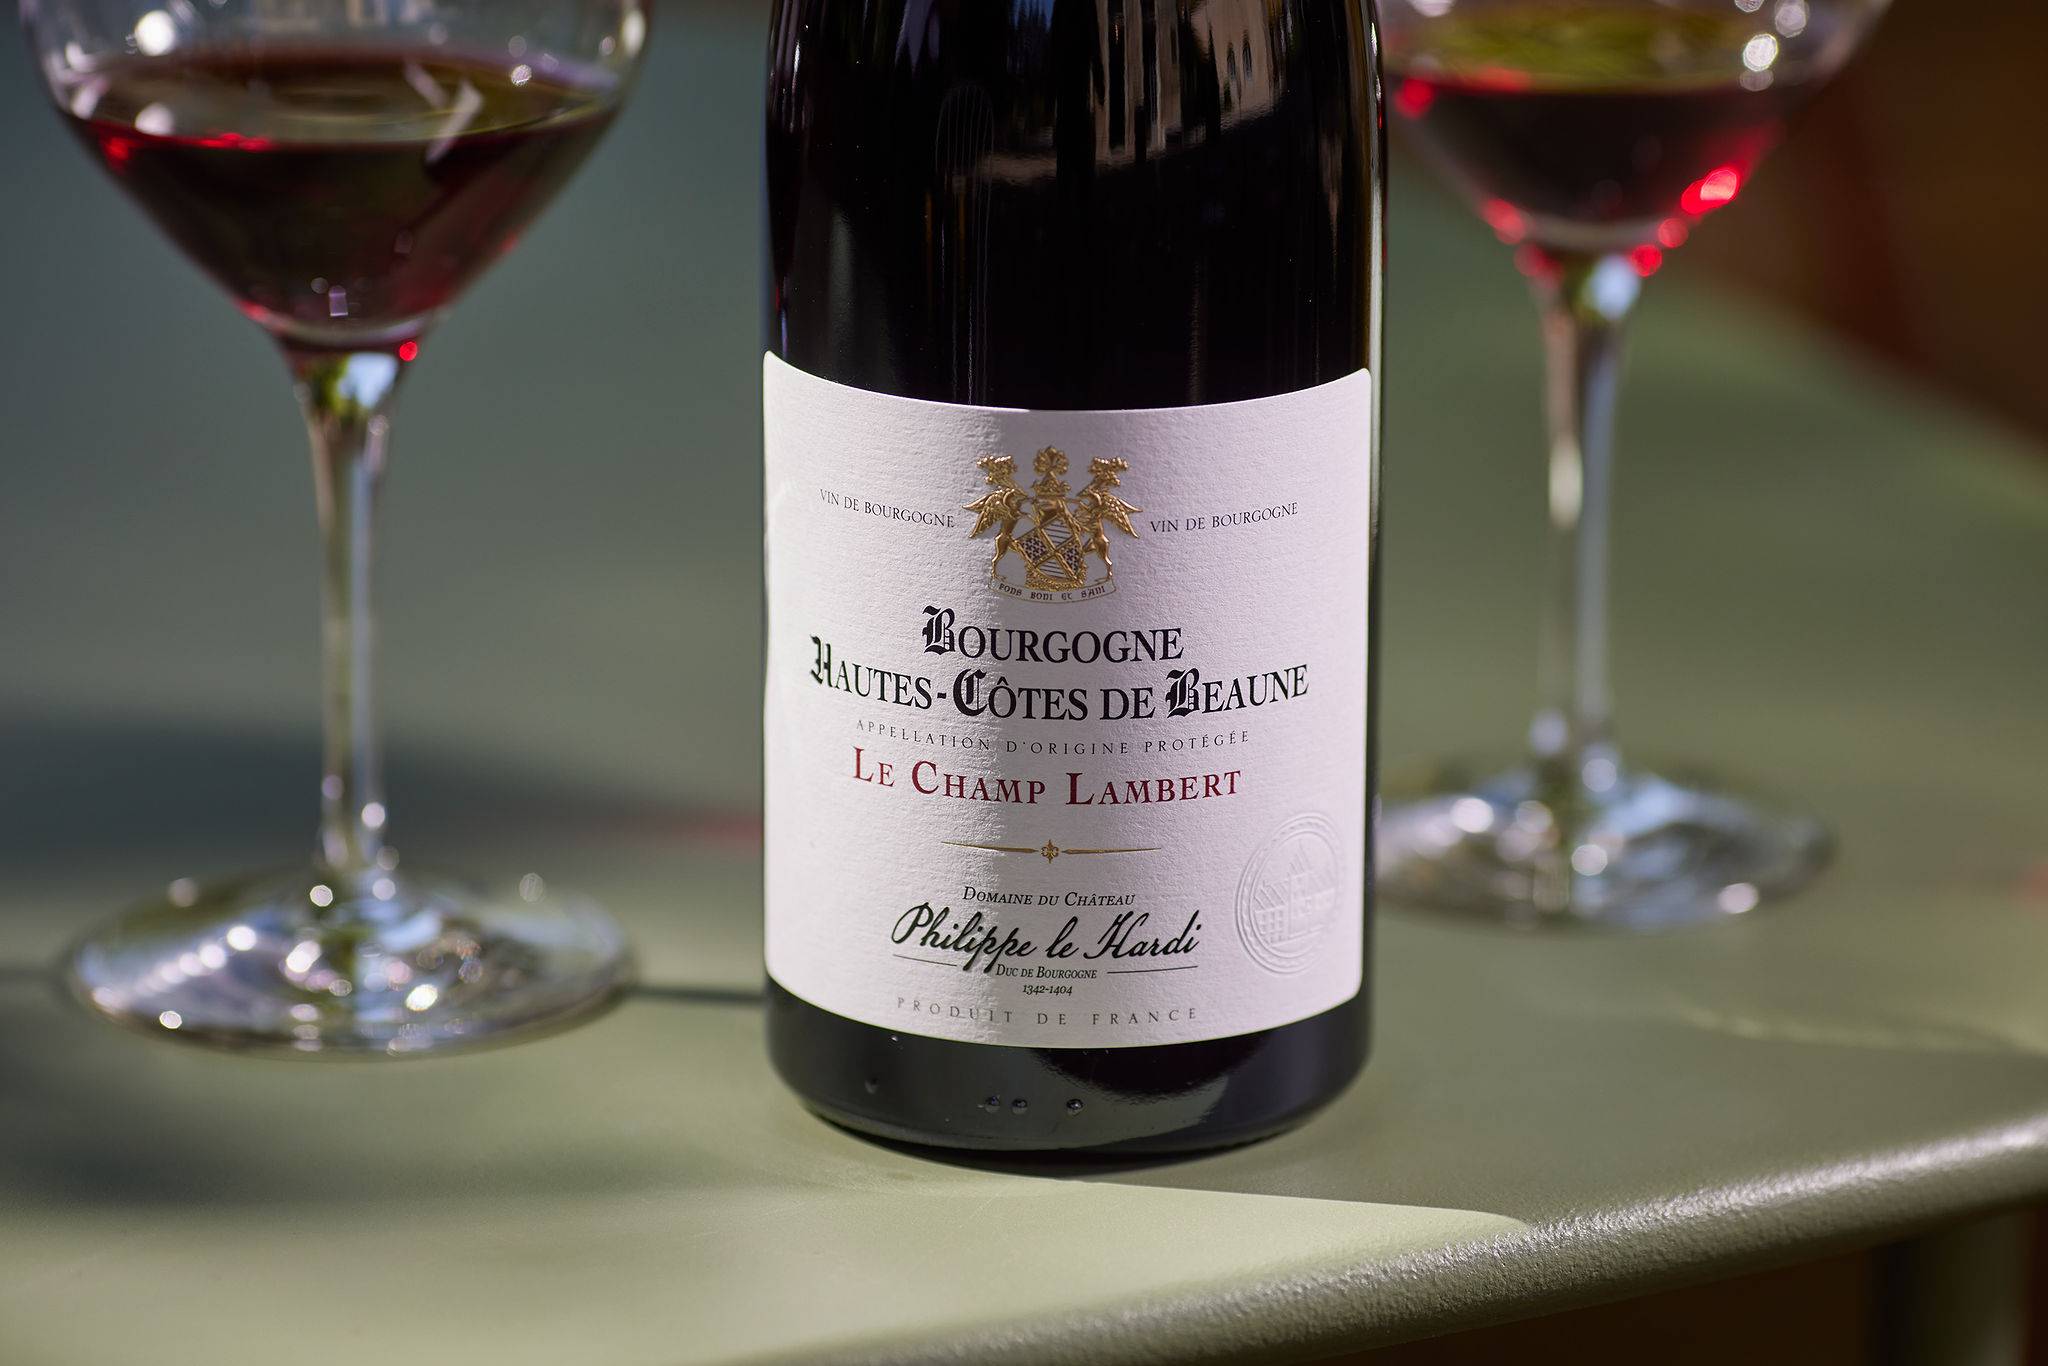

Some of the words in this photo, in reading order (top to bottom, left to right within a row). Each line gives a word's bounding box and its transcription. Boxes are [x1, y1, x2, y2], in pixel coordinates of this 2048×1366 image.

[820, 488, 840, 505] VIN
[844, 497, 860, 511] DE
[865, 501, 955, 528] BOURGOGNE
[1149, 519, 1179, 533] VIN
[1186, 517, 1206, 531] DE
[1212, 502, 1298, 529] BOURGOGNE
[922, 606, 1184, 664] BOURGOGNE
[810, 634, 1089, 721] HAUTES-CÔTES
[1099, 687, 1156, 720] DE
[1165, 664, 1308, 718] BEAUNE
[856, 720, 990, 751] APPELLATION
[1006, 740, 1128, 755] D'ORIGINE
[1144, 730, 1249, 753] PROTÉGÉE
[853, 746, 895, 787] LE
[911, 761, 1046, 804] CHAMP
[1065, 770, 1241, 805] LAMBERT
[962, 886, 1033, 905] DOMAINE
[1038, 894, 1059, 906] DU
[1064, 891, 1136, 906] CHÂTEAU
[891, 901, 1037, 974] Philippe
[1045, 916, 1079, 959] le
[1083, 910, 1202, 959] Hardi
[995, 964, 1019, 977] DUC
[1020, 968, 1034, 978] DE
[1036, 966, 1097, 979] BOURGOGNE
[1022, 984, 1073, 996] 1342-1404
[897, 997, 1013, 1023] PRODUIT
[1038, 1012, 1067, 1026] DE
[1092, 1007, 1197, 1025] FRANCE
